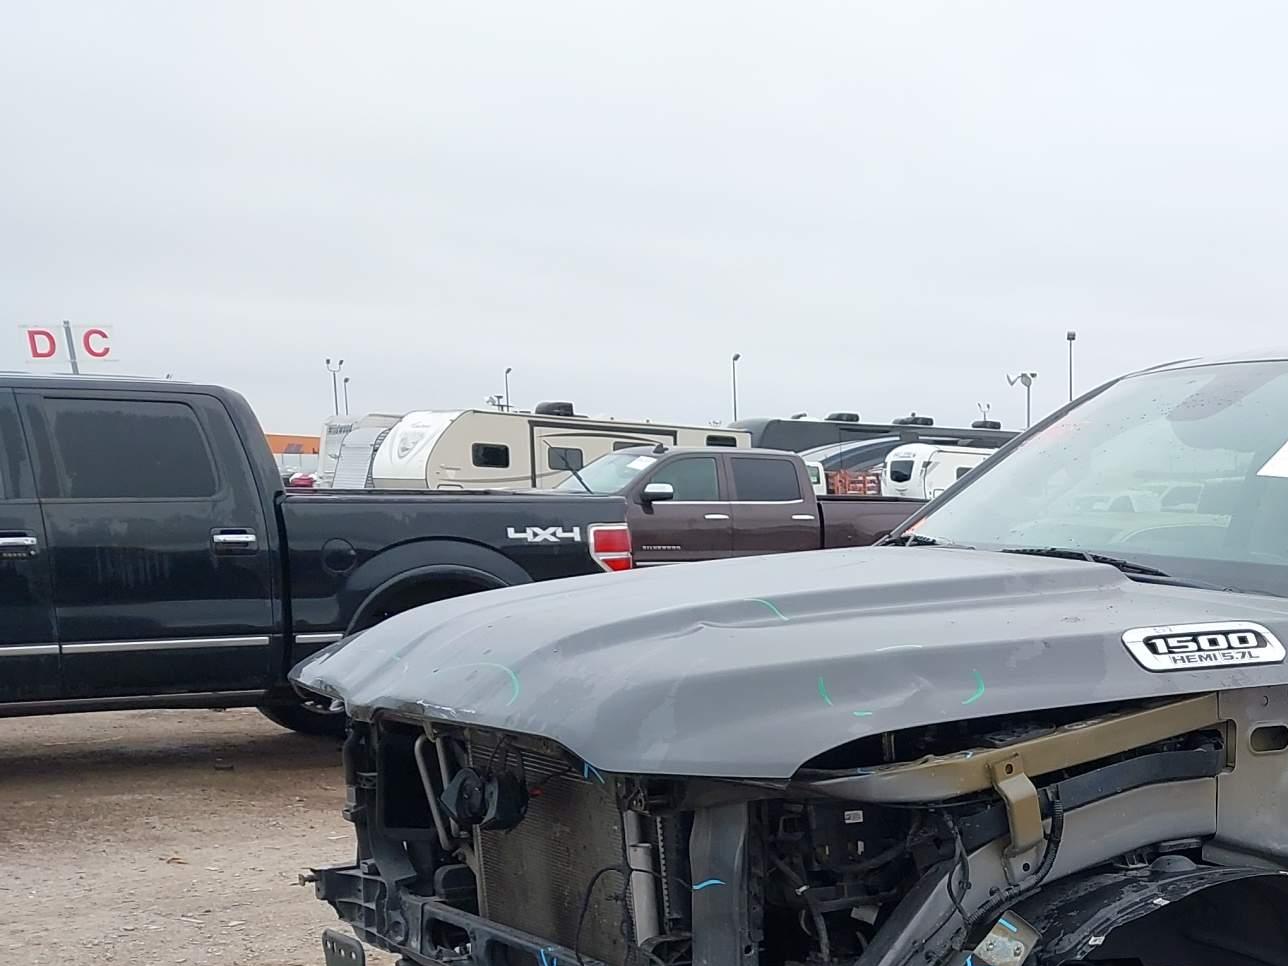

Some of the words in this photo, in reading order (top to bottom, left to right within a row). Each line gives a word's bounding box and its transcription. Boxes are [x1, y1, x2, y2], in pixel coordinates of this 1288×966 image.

[27, 329, 57, 358] D
[82, 328, 110, 358] C
[506, 526, 582, 542] 4X4
[1148, 632, 1258, 653] 1500
[1171, 654, 1218, 664] HEMI
[1223, 650, 1260, 661] 5.7L
